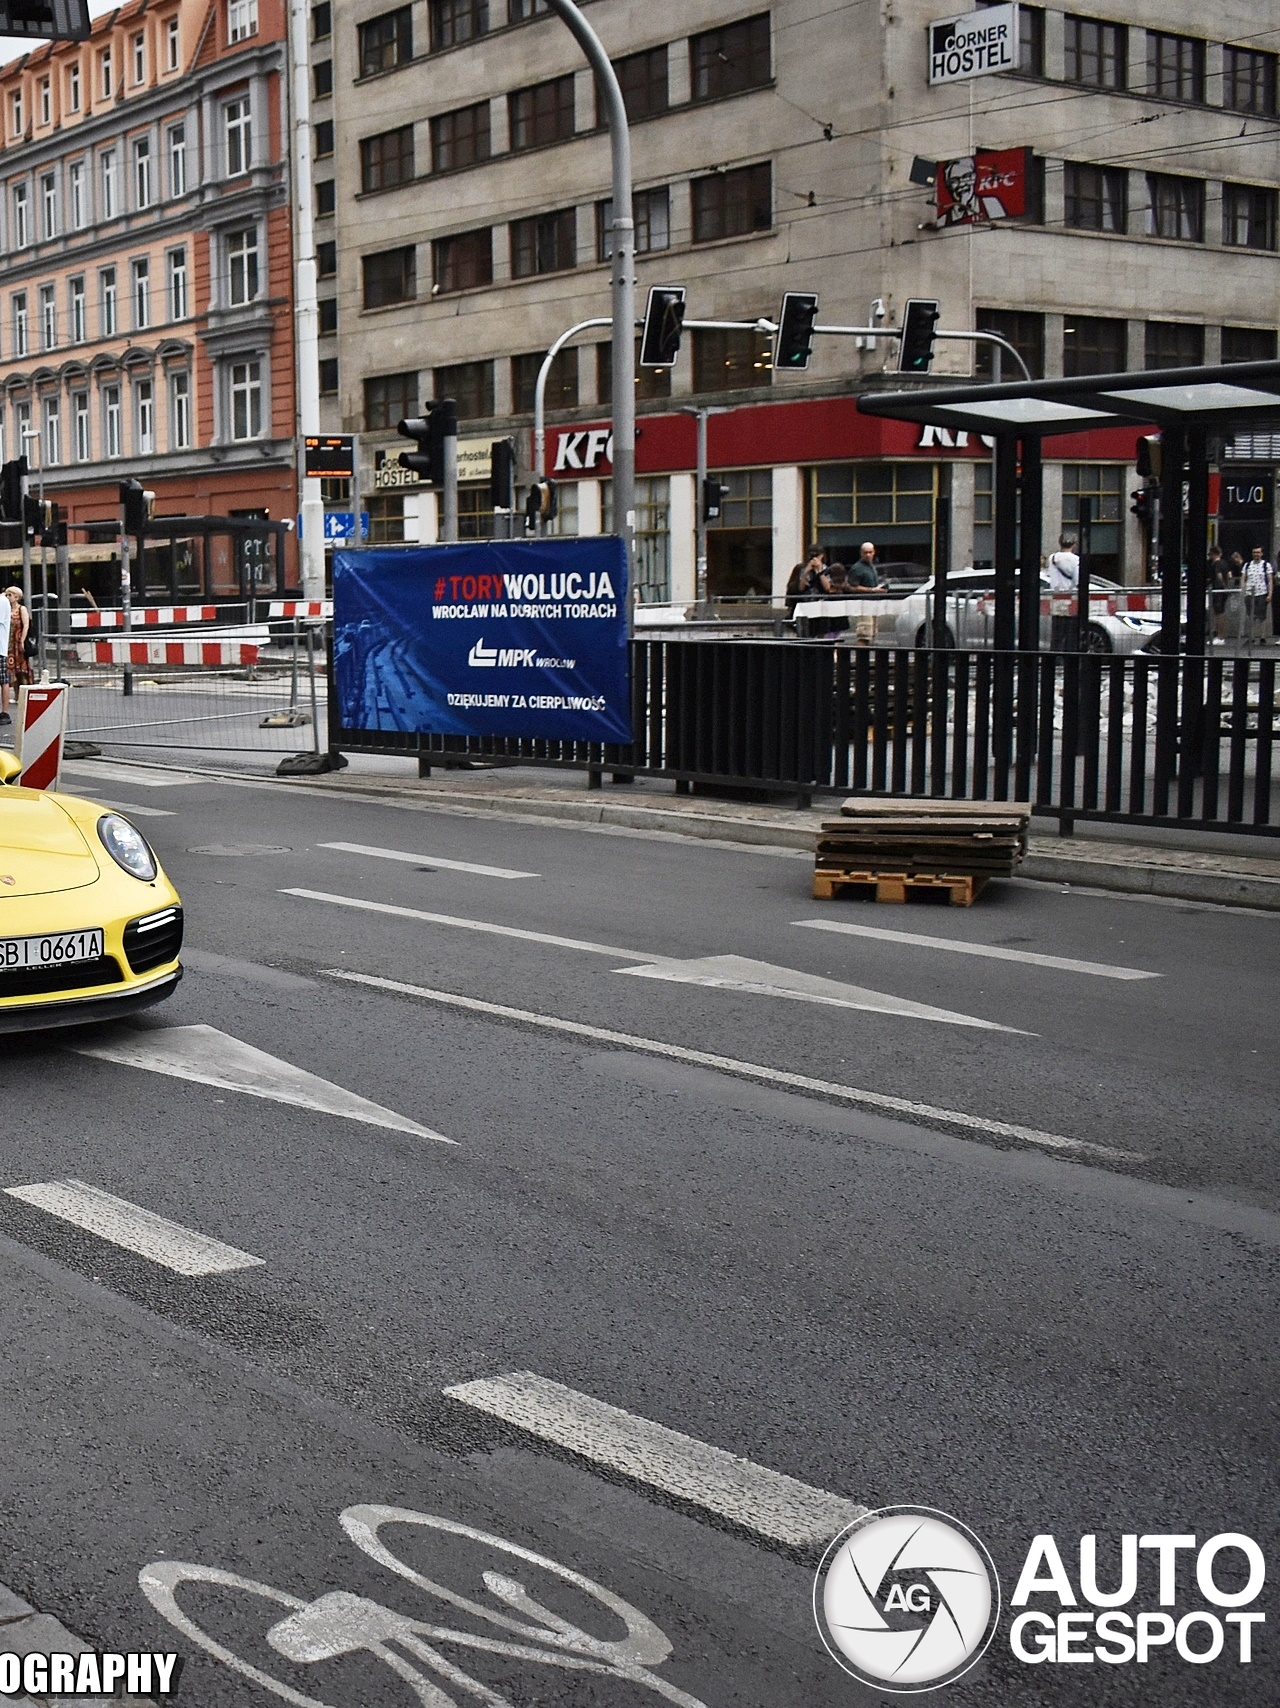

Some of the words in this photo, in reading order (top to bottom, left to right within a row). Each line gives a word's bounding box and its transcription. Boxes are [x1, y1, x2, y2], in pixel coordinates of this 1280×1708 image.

[945, 24, 1008, 51] CORNER
[932, 42, 1011, 78] HOSTEL
[978, 171, 1017, 191] KFC
[553, 429, 614, 470] KF
[375, 470, 417, 486] HOSTEL
[433, 572, 616, 600] #TORYWOLUCJA
[432, 604, 489, 619] WROCŁAW
[491, 604, 508, 618] NA
[510, 603, 562, 618] DOBRYCH
[564, 603, 617, 618] TORACH
[498, 649, 537, 667] MPK
[447, 693, 510, 709] DZIĘKUJEMY
[512, 695, 527, 708] ZA
[529, 695, 606, 711] CIERPLIWOŚĆ
[39, 933, 100, 962] 0661A
